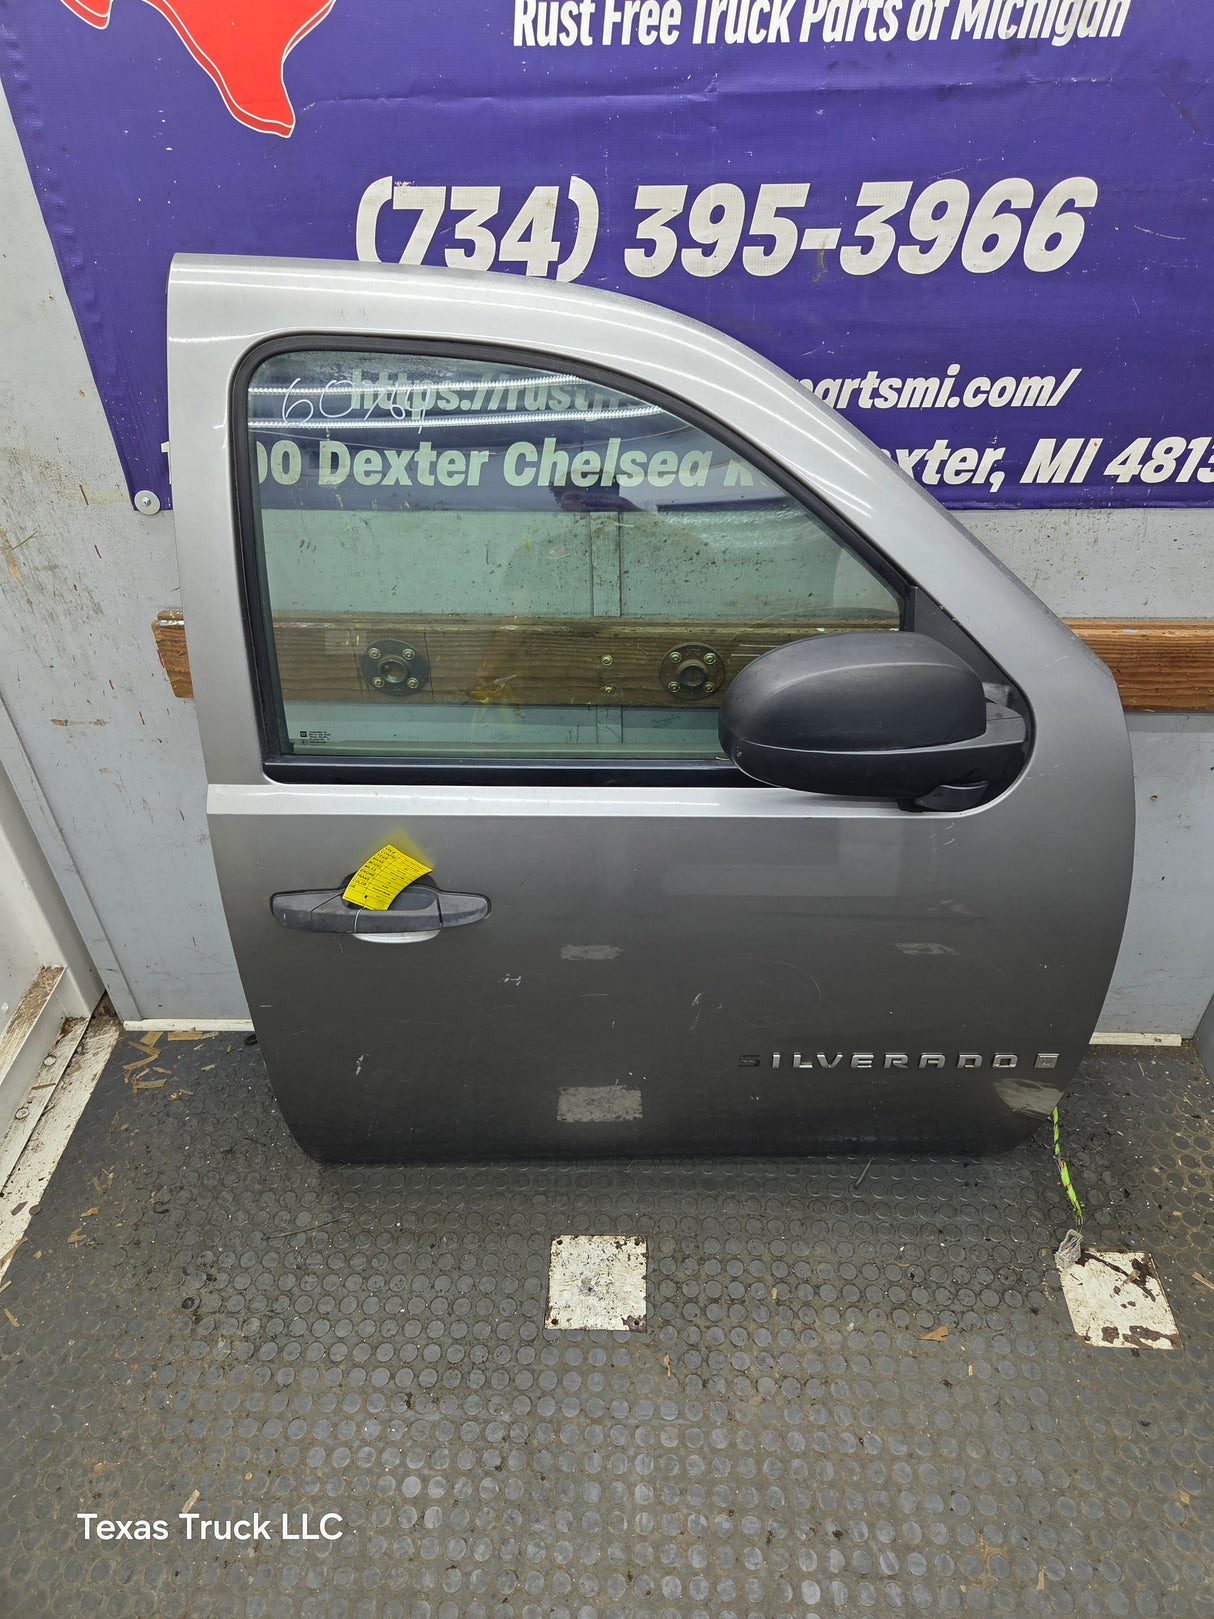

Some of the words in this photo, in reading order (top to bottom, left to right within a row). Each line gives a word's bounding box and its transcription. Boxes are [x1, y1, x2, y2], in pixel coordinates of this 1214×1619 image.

[513, 0, 595, 48] Rust
[602, 0, 683, 47] Free
[692, 0, 796, 45] Truck
[799, 0, 903, 44] Parts
[906, 0, 950, 42] of
[951, 0, 1132, 47] Michigan
[355, 175, 600, 283] (734)
[623, 176, 1099, 278] 395-3966
[318, 440, 490, 487] Dexter
[503, 437, 713, 488] Chelsea
[1019, 438, 1104, 484] MI
[738, 1052, 1018, 1069] SILVERADO
